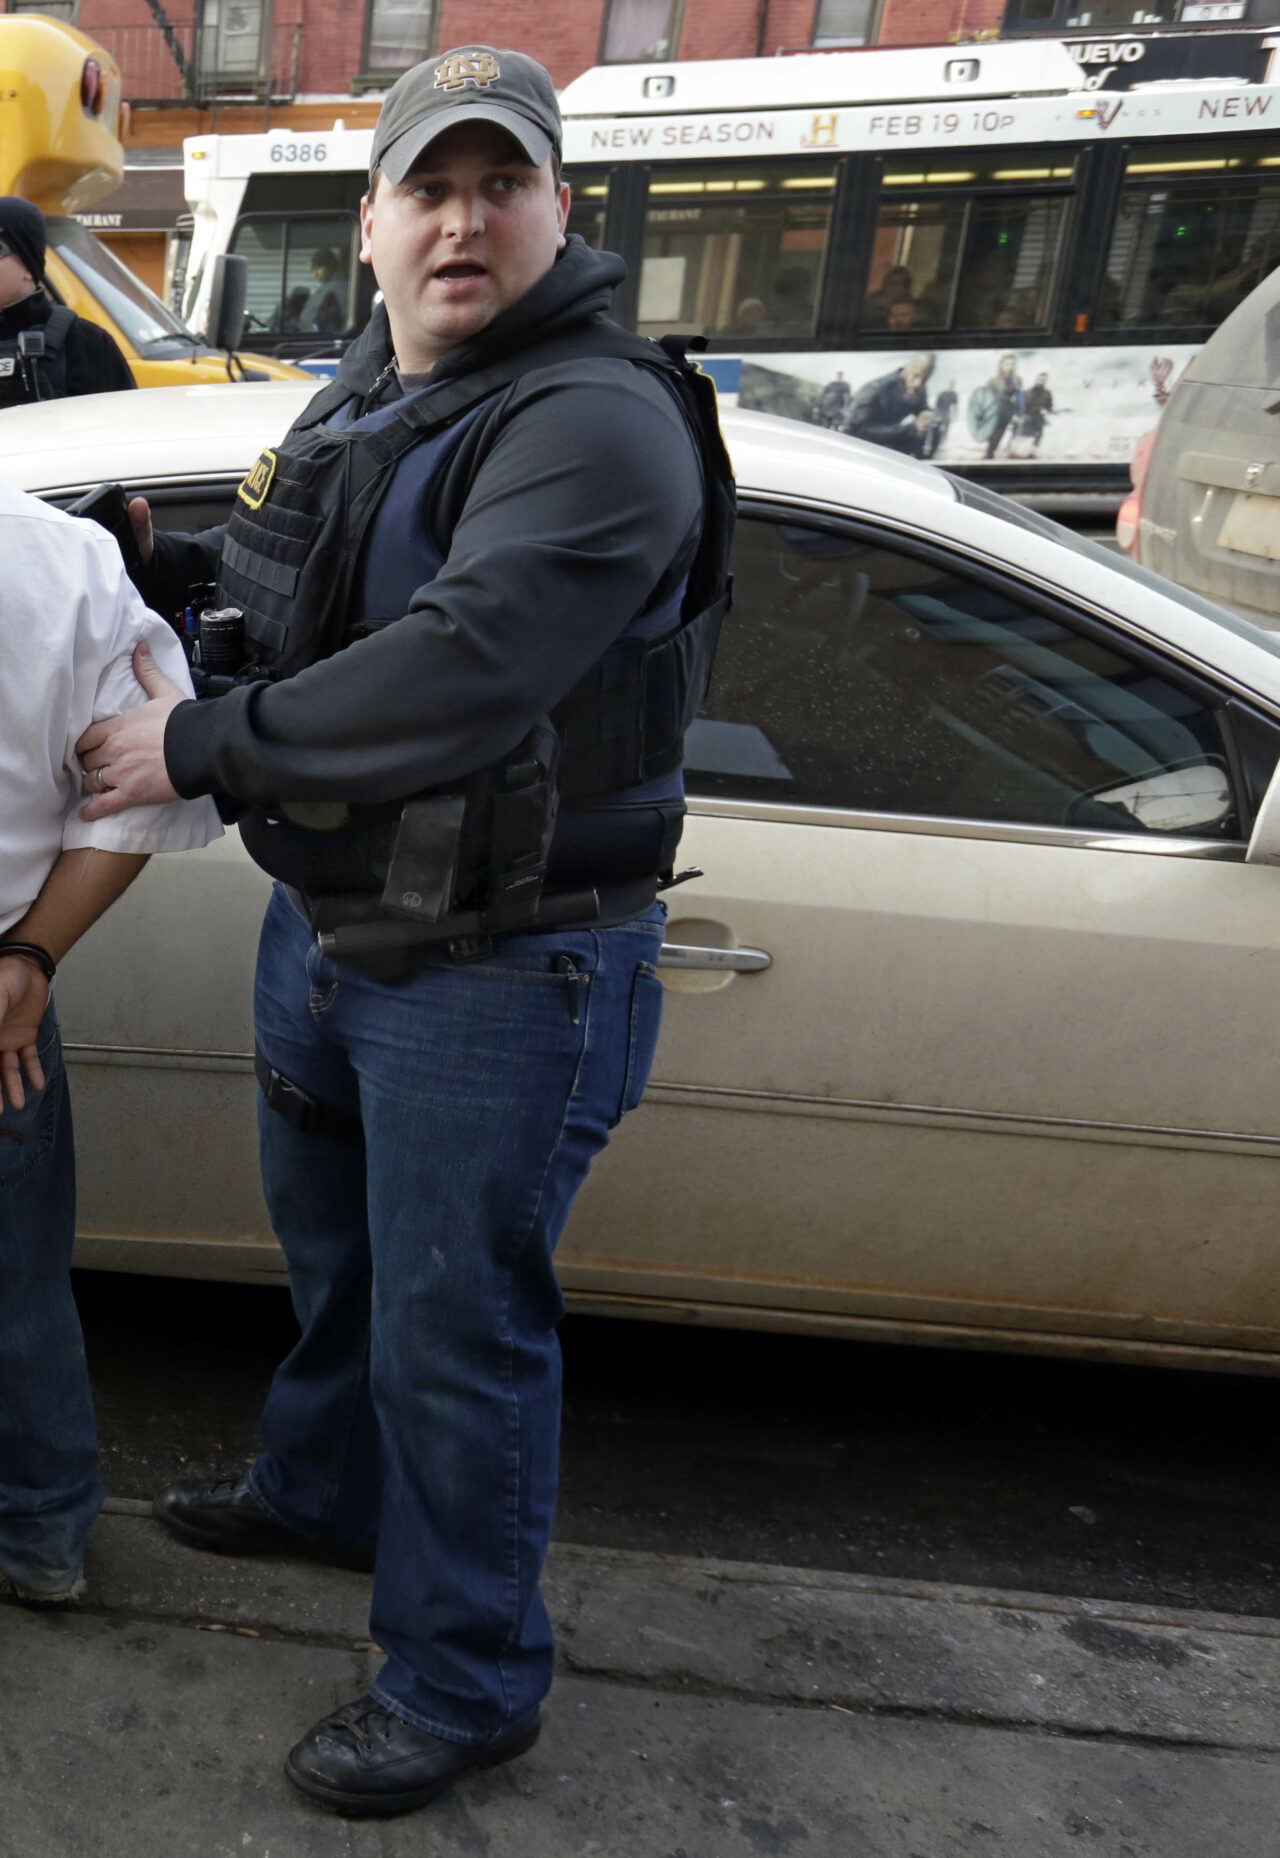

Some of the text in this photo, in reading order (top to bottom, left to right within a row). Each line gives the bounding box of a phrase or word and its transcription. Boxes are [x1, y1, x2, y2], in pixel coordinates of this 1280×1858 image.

[591, 129, 653, 148] NEW
[663, 122, 774, 146] SEASON
[869, 116, 921, 135] FEB
[932, 113, 959, 133] 19
[1198, 96, 1272, 119] NEW
[271, 144, 326, 162] 6386
